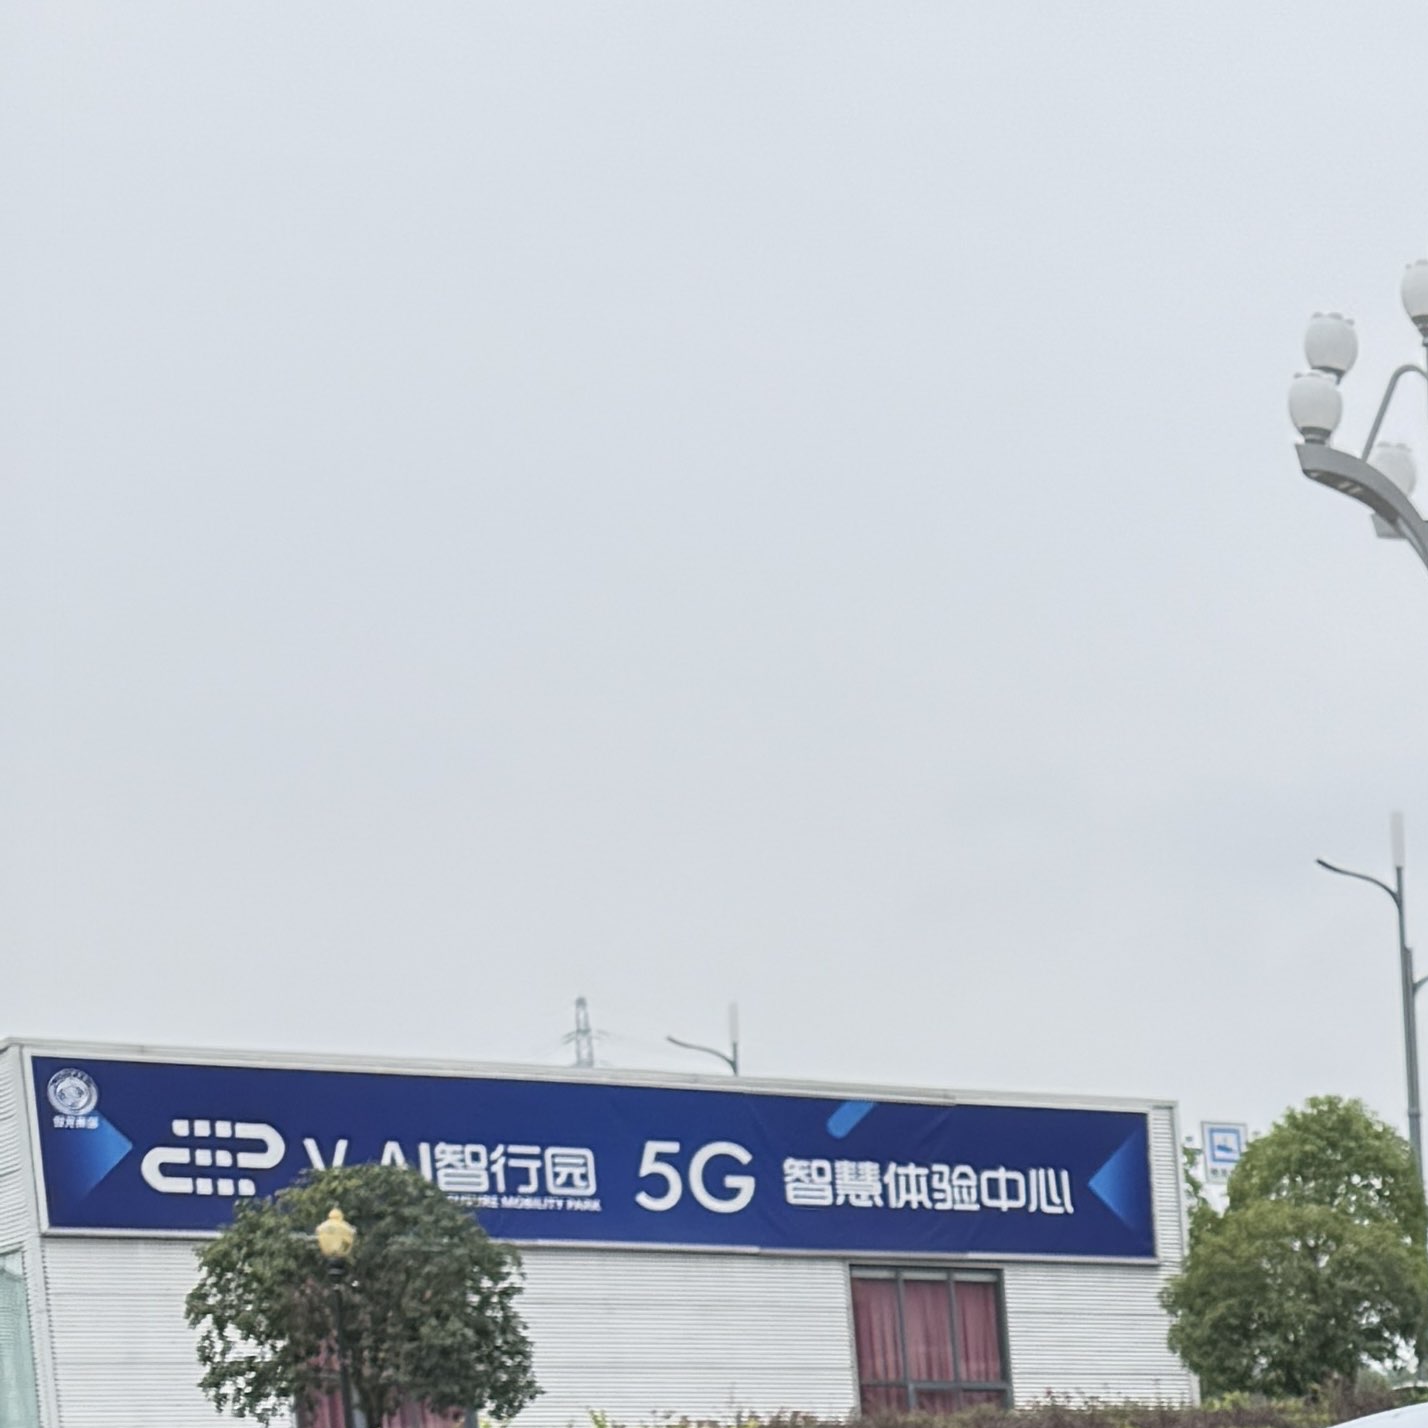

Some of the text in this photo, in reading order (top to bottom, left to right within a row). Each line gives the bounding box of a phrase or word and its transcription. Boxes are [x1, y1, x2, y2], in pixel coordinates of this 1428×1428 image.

[635, 1140, 755, 1213] 5G
[783, 1157, 1074, 1214] 智慧体验中心
